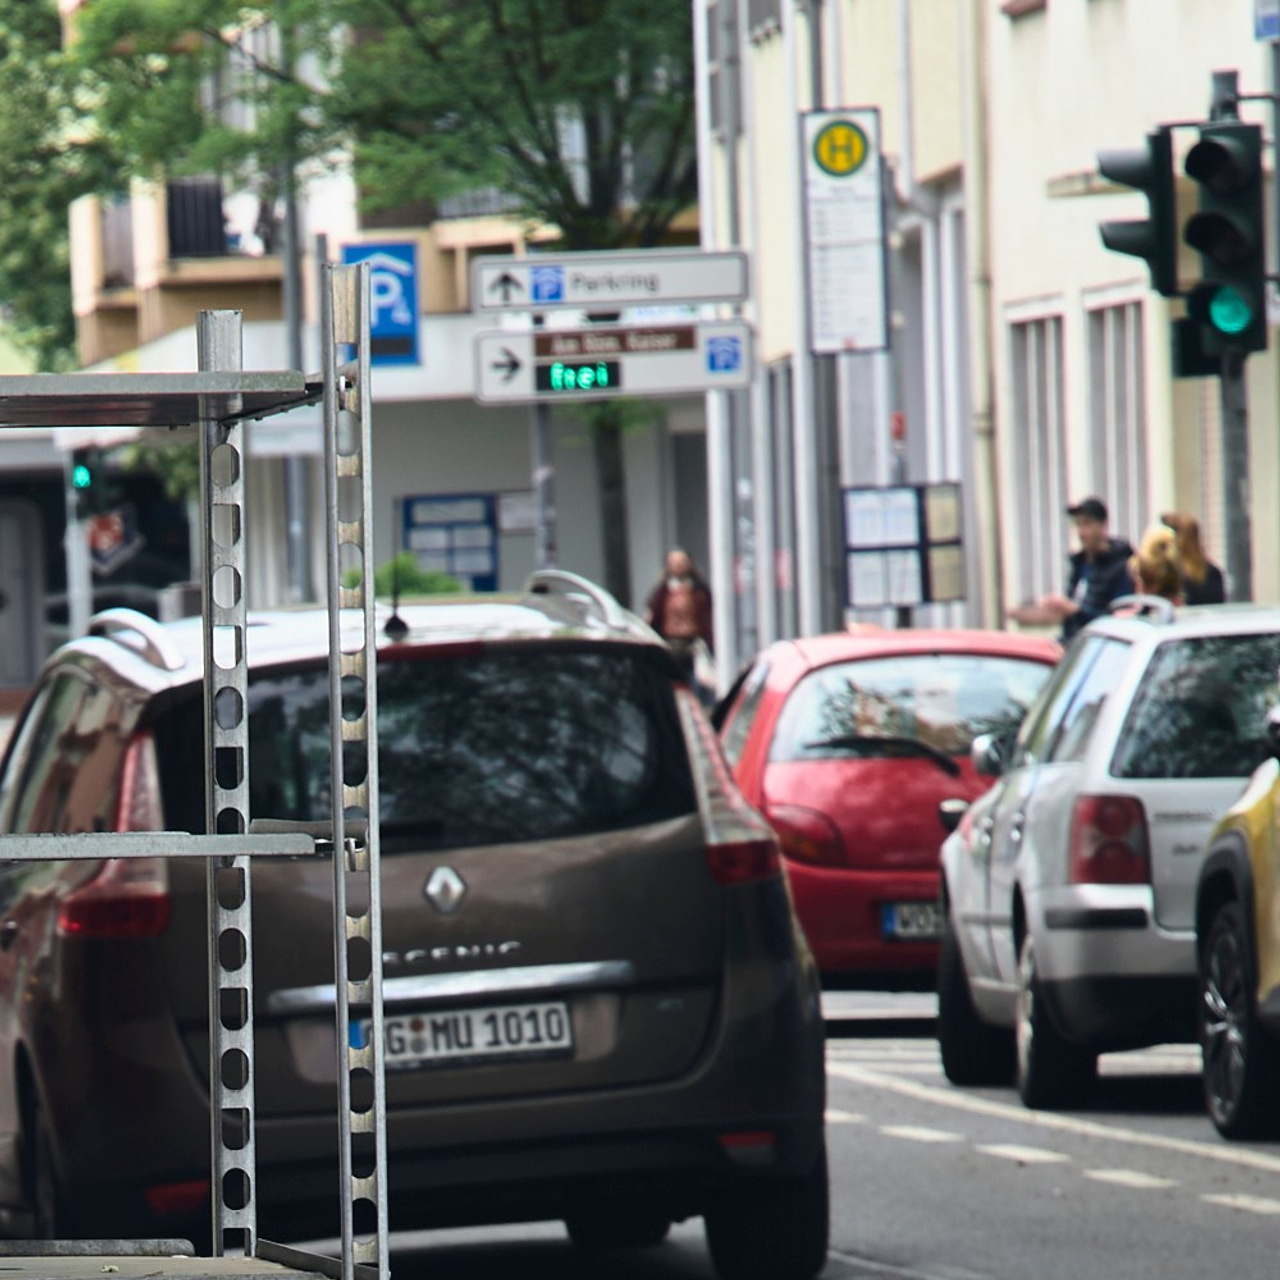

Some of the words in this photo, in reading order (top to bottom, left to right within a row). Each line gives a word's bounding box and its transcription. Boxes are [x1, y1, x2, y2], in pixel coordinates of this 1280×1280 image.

[571, 271, 658, 292] Parkring
[550, 362, 609, 392] frei
[431, 1014, 473, 1049] MU
[484, 1006, 565, 1047] 1010
